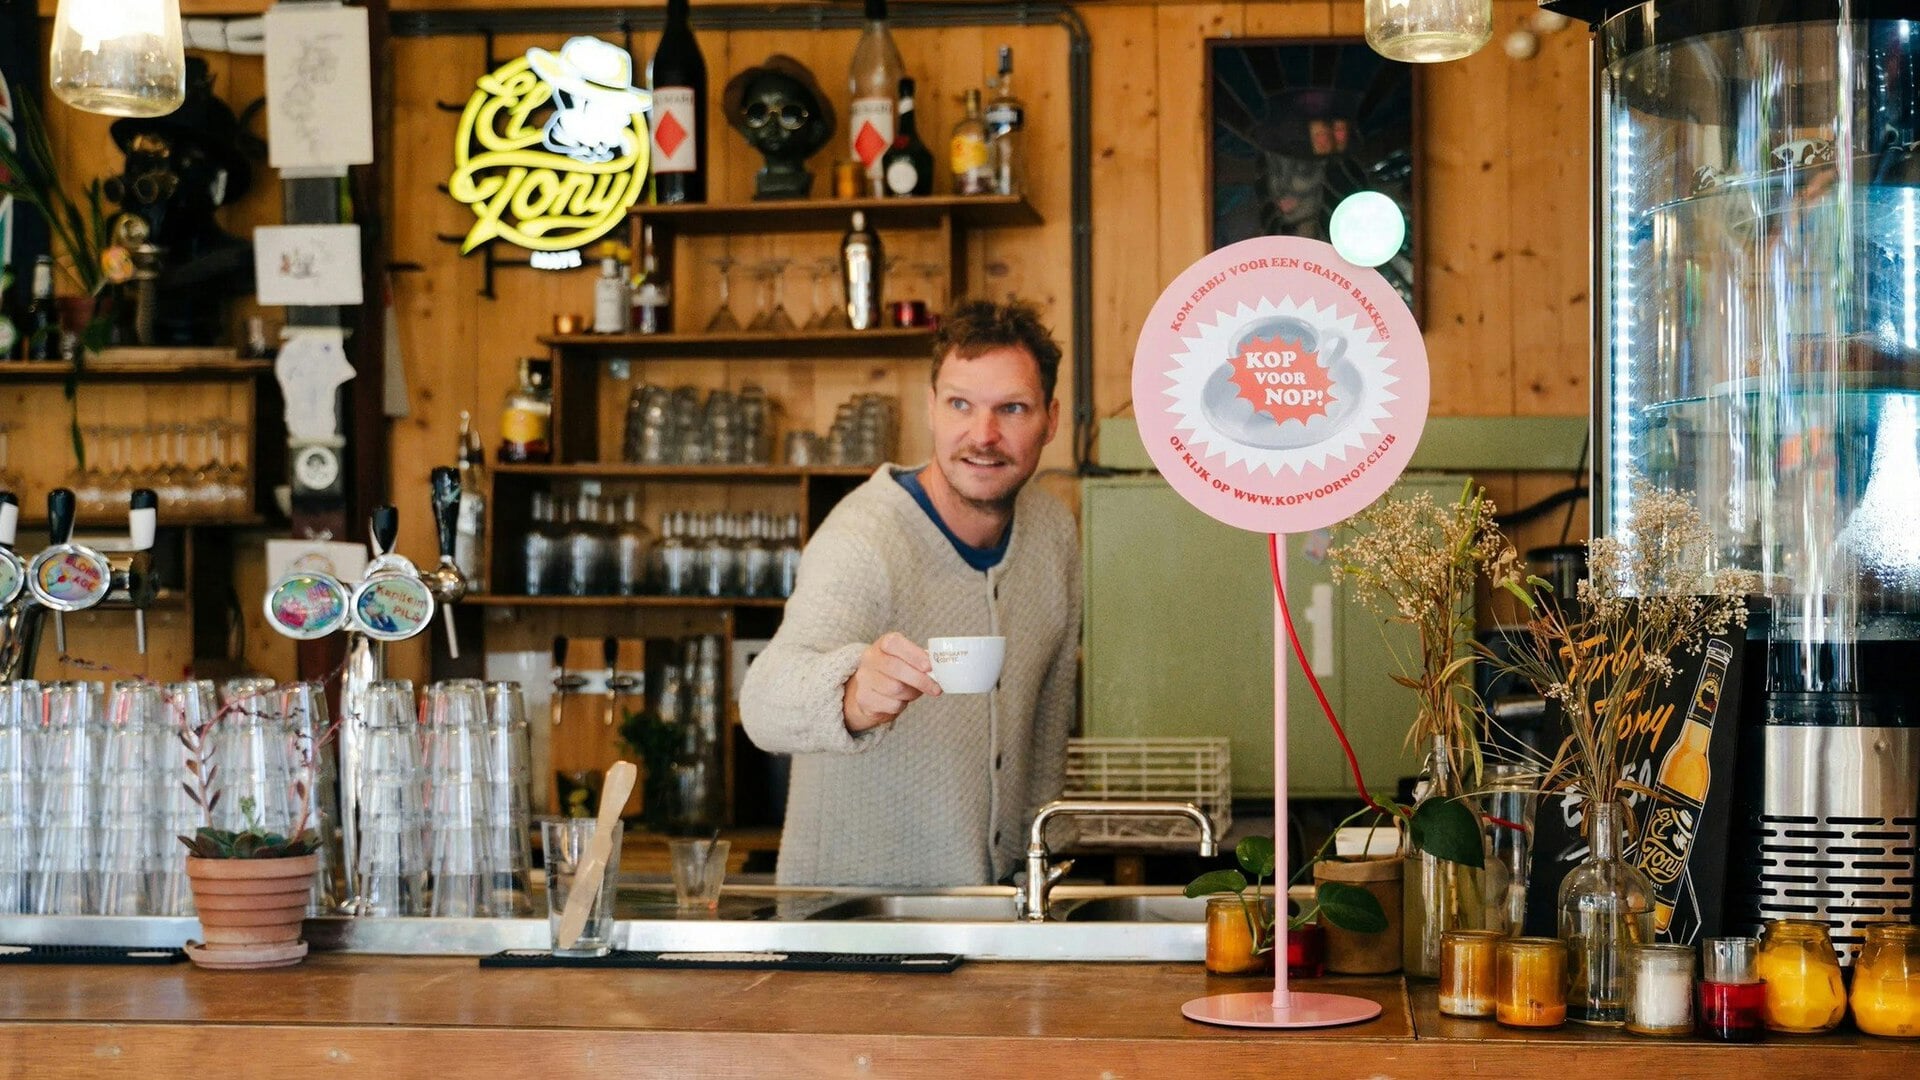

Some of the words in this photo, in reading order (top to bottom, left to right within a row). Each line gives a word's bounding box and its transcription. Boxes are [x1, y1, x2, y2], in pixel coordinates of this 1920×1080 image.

[475, 69, 554, 152] El
[450, 164, 632, 246] Tony
[1170, 302, 1194, 332] KOM
[1191, 273, 1228, 304] ERBIJ
[1229, 258, 1269, 278] VOOR
[1271, 257, 1299, 269] EEN
[1303, 261, 1352, 291] GRATIS
[1350, 287, 1391, 340] BAKKIE!
[1245, 350, 1297, 369] KOP
[1254, 371, 1307, 385] VOOR
[1264, 388, 1324, 407] NOP!
[1169, 435, 1186, 453] OF
[1182, 451, 1210, 482] KIJK
[1211, 478, 1231, 494] OP
[1233, 432, 1397, 507] WWW.KOPVOORNOP.CLUB
[1641, 840, 1684, 879] Tony
